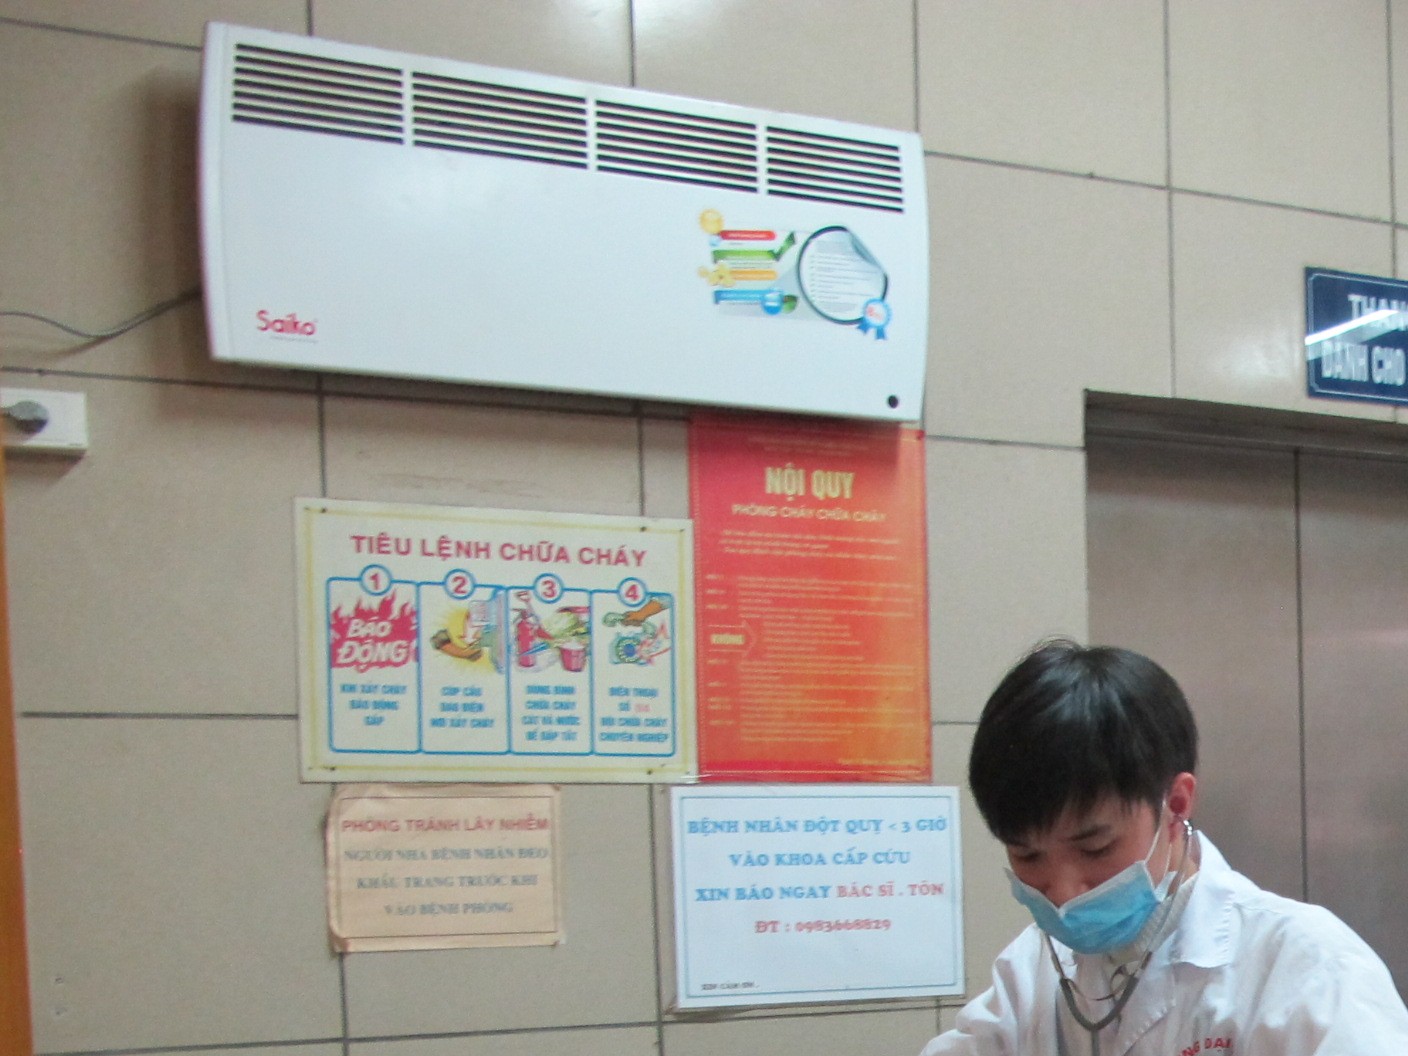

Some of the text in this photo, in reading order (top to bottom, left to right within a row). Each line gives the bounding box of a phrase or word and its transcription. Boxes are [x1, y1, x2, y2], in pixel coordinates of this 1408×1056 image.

[256, 309, 316, 336] Saiko
[765, 462, 806, 502] NỘI
[350, 532, 647, 567] TIÊU LỆNH CHỮA CHÁY
[368, 572, 381, 590] 1
[453, 576, 468, 595] 2
[541, 579, 556, 598] 3
[625, 584, 639, 601] 4
[348, 616, 392, 638] BÁO
[463, 816, 496, 832] LÂY
[687, 816, 740, 837] BỆNH
[744, 816, 798, 833] NHÂN
[803, 816, 841, 835] ĐỘT
[901, 819, 911, 833] 3
[916, 815, 948, 832] GIỜ
[728, 846, 912, 867] VÀO KHOA CẤP CỨU
[695, 887, 730, 901] XIN
[735, 883, 774, 900] BÁO
[779, 885, 833, 899] NGAY
[836, 881, 873, 898] BÁC
[754, 920, 781, 935] ĐT
